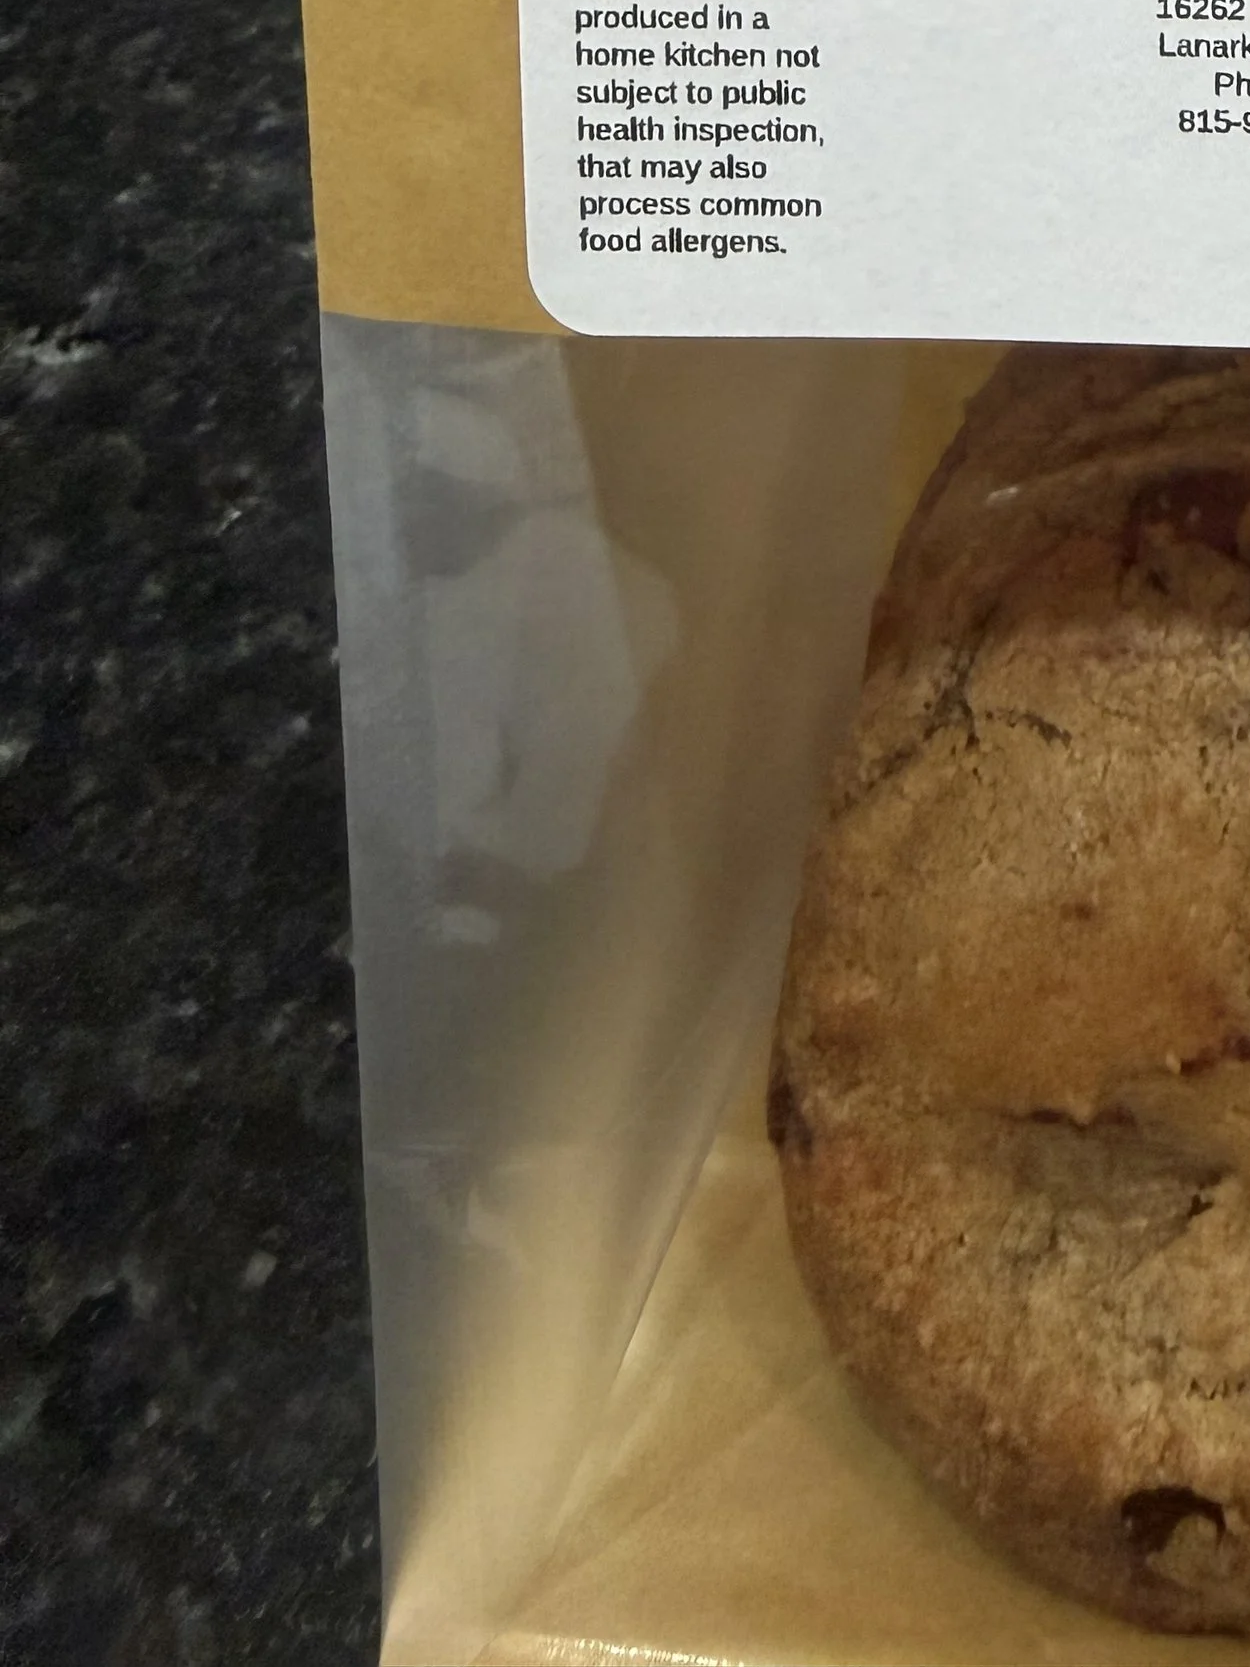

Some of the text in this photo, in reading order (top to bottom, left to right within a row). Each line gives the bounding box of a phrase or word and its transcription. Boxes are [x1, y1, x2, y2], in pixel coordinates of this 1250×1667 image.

[573, 2, 772, 36] produced in a
[574, 39, 822, 70] home kitchen not
[575, 77, 808, 112] subject to public
[576, 113, 825, 149] health inspection,
[575, 151, 768, 187] that may also
[578, 194, 823, 222] process common
[577, 224, 789, 261] food allergens.
